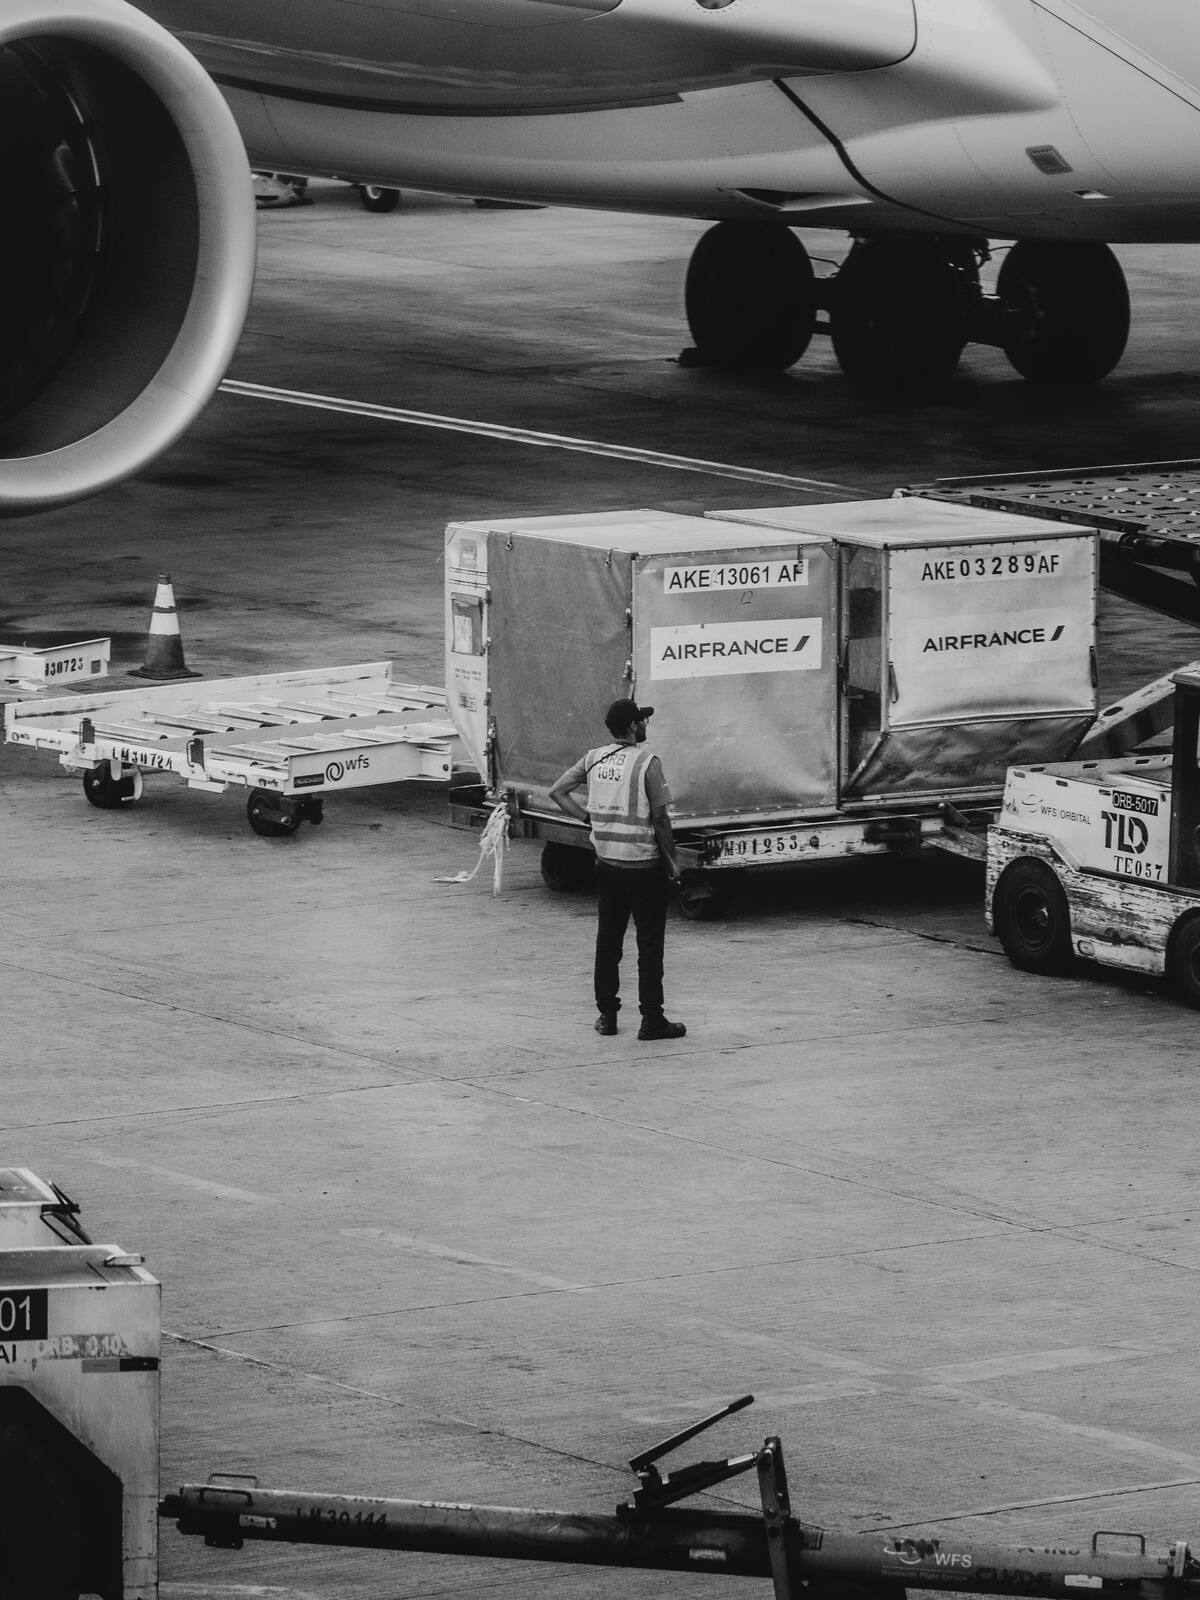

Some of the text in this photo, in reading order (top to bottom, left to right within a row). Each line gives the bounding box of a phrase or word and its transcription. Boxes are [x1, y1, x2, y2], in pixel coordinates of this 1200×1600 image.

[669, 570, 711, 590] AKE
[717, 566, 769, 586] 13061
[345, 754, 370, 771] wfs
[1041, 805, 1092, 825] WFS ORBITAL
[1113, 792, 1158, 815] ORB-5017
[1101, 810, 1149, 855] TLD
[1113, 854, 1163, 881] TE057
[935, 1552, 973, 1569] WFS
